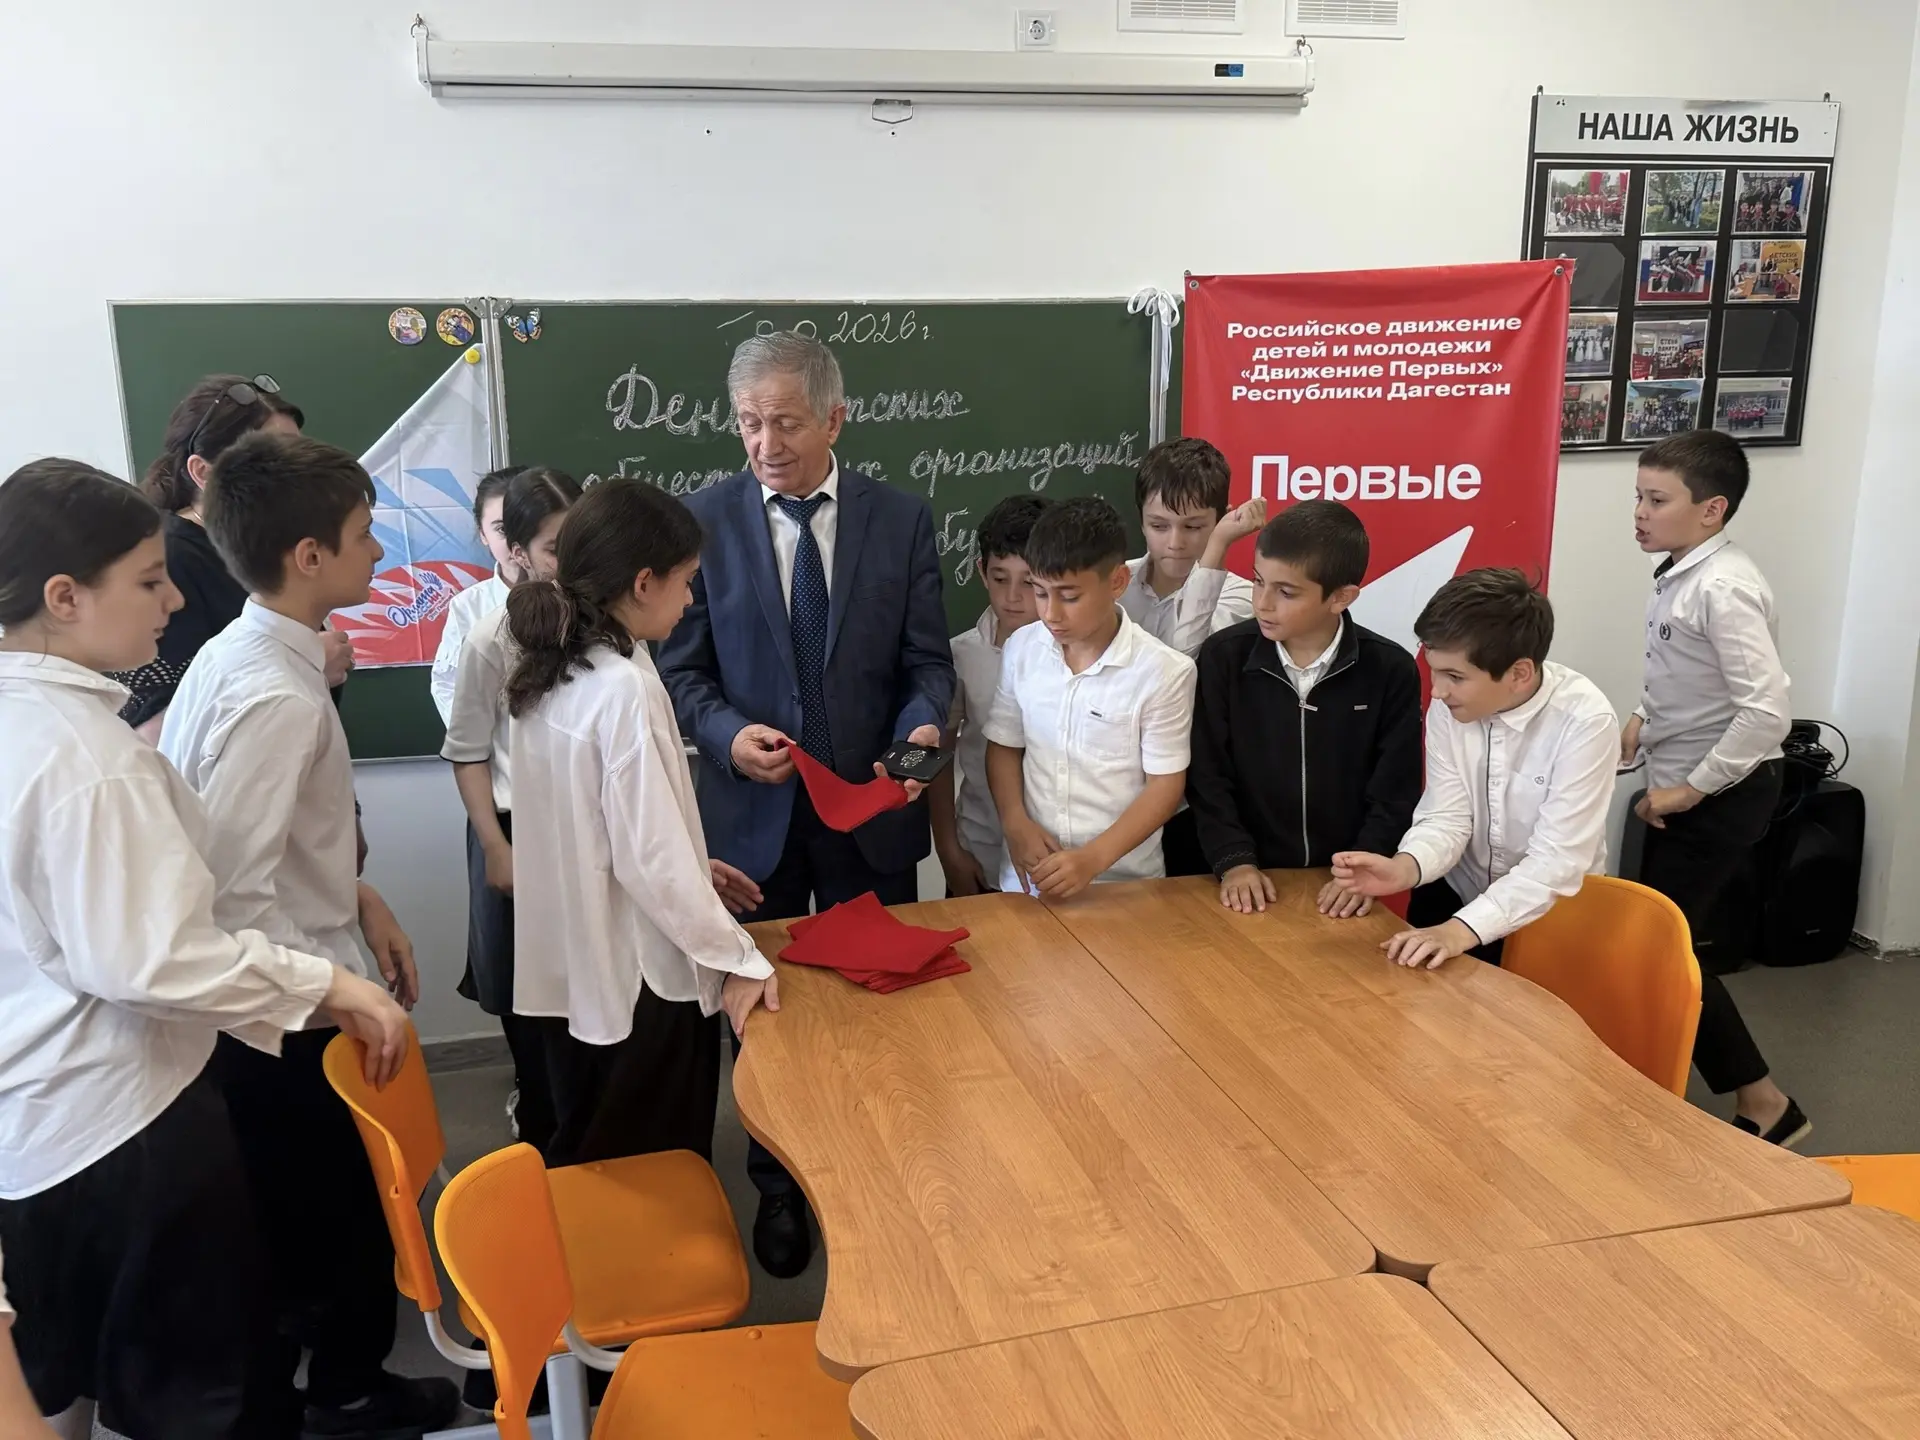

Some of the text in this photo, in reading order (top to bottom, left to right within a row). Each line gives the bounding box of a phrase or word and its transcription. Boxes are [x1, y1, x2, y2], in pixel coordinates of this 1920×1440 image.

[1578, 112, 1799, 144] НАША ЖИЗНЬ
[1227, 316, 1522, 339] Российское движение
[1252, 340, 1492, 361] детей и молодежи
[1240, 360, 1503, 383] «Движение Первых»
[1232, 382, 1511, 404] Республики Дагестан
[843, 388, 971, 422] тских
[1251, 455, 1482, 501] Первые
